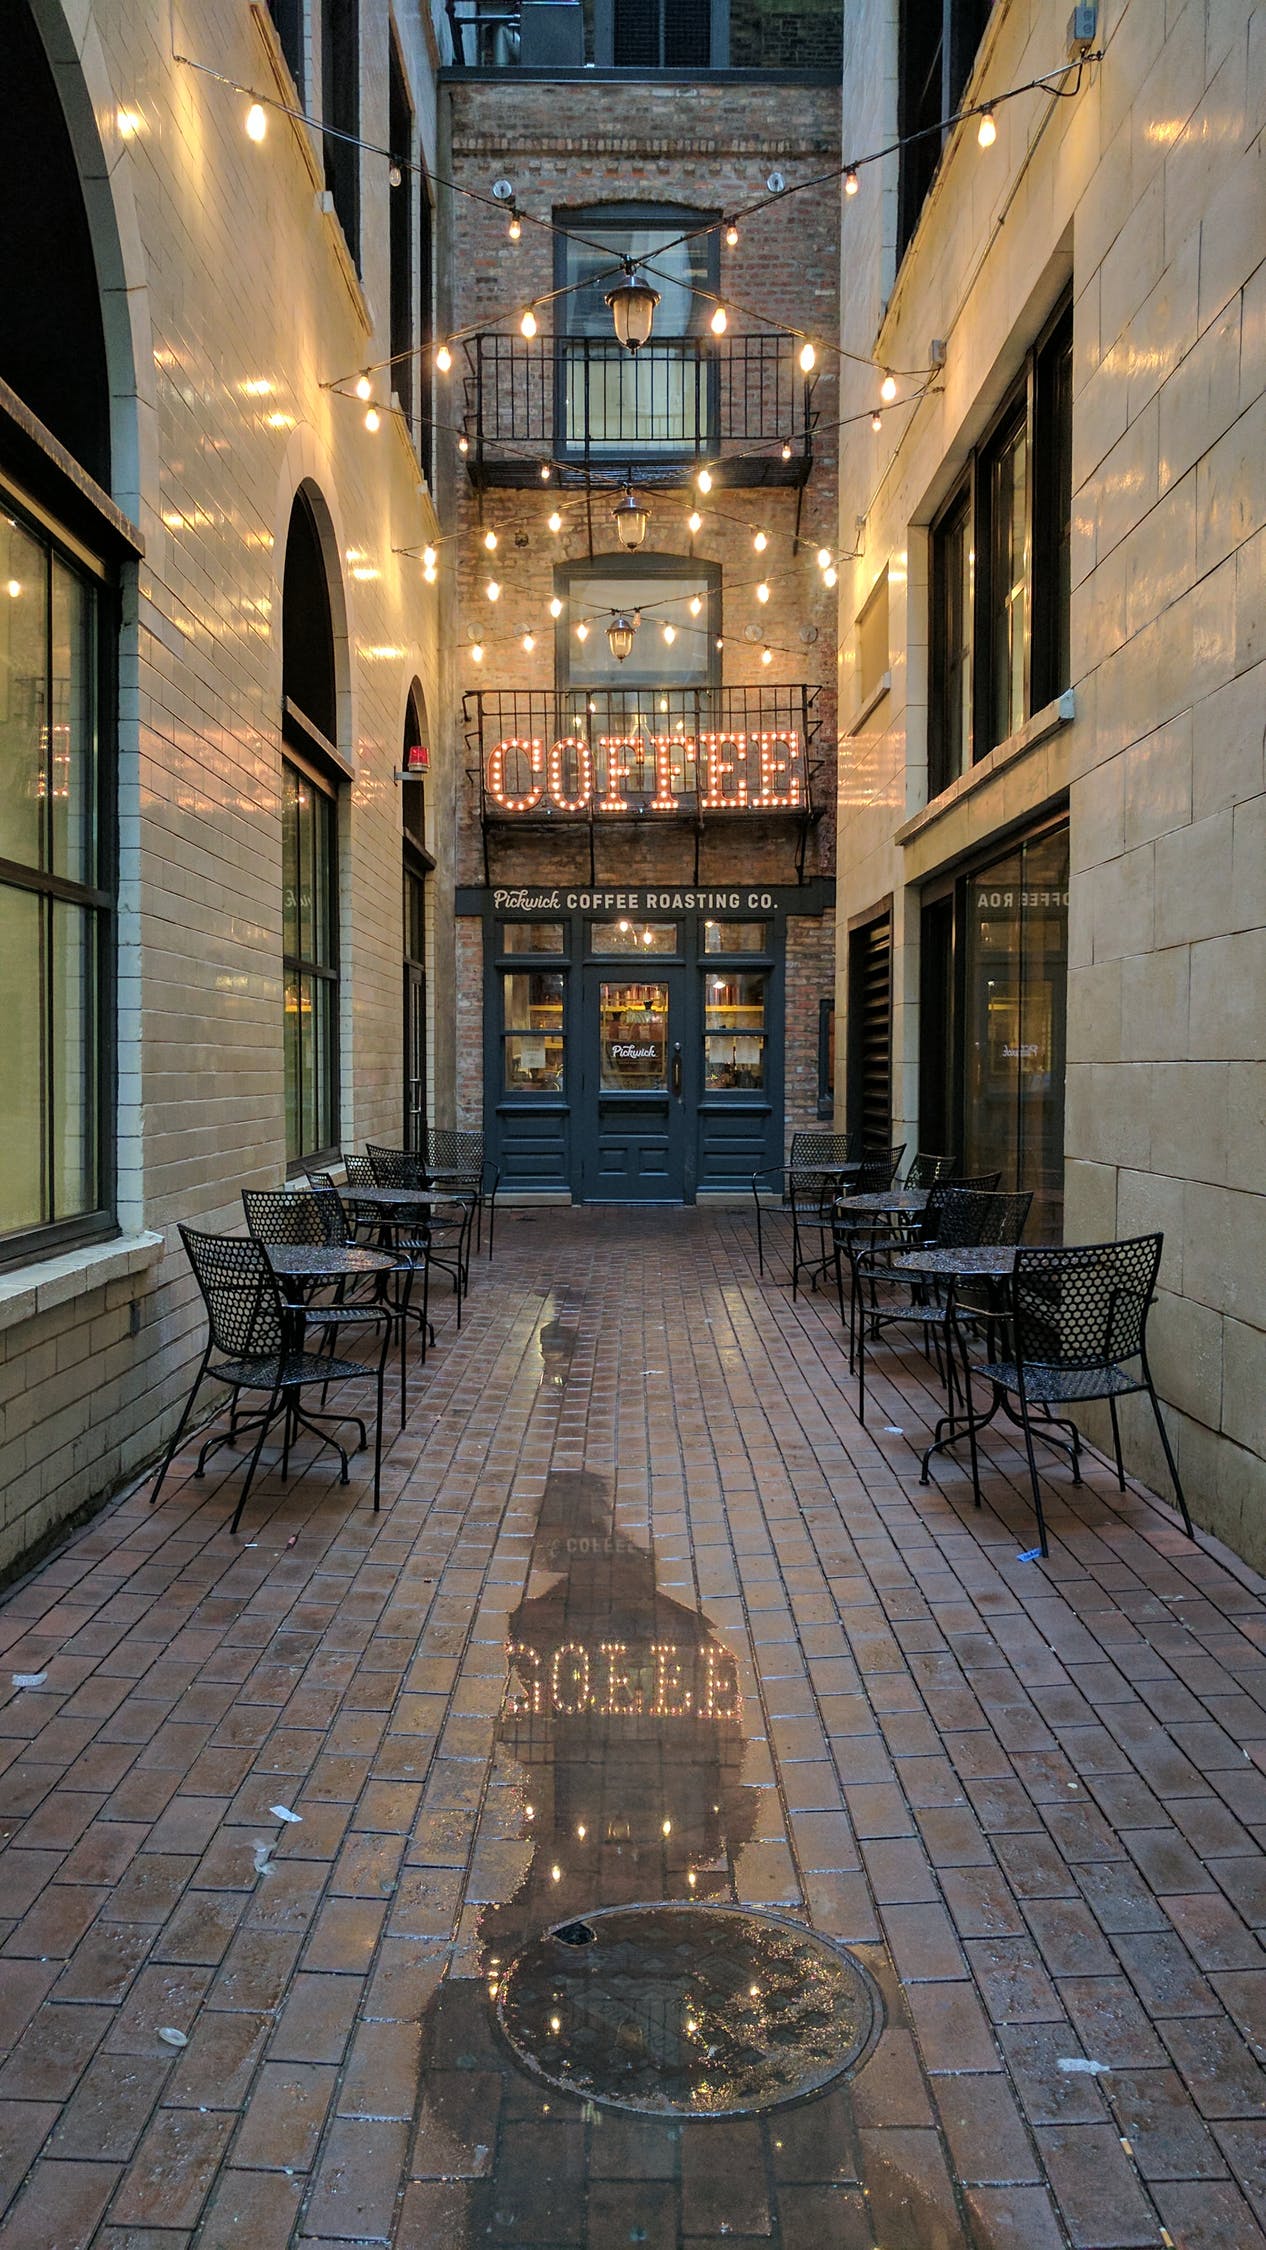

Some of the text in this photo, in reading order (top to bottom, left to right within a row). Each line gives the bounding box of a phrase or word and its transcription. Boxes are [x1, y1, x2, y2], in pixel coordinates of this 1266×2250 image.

[487, 731, 801, 812] COFFEE
[493, 889, 778, 911] Pickwick COFFEE ROASTING CO.
[612, 1044, 656, 1059] Pickwick
